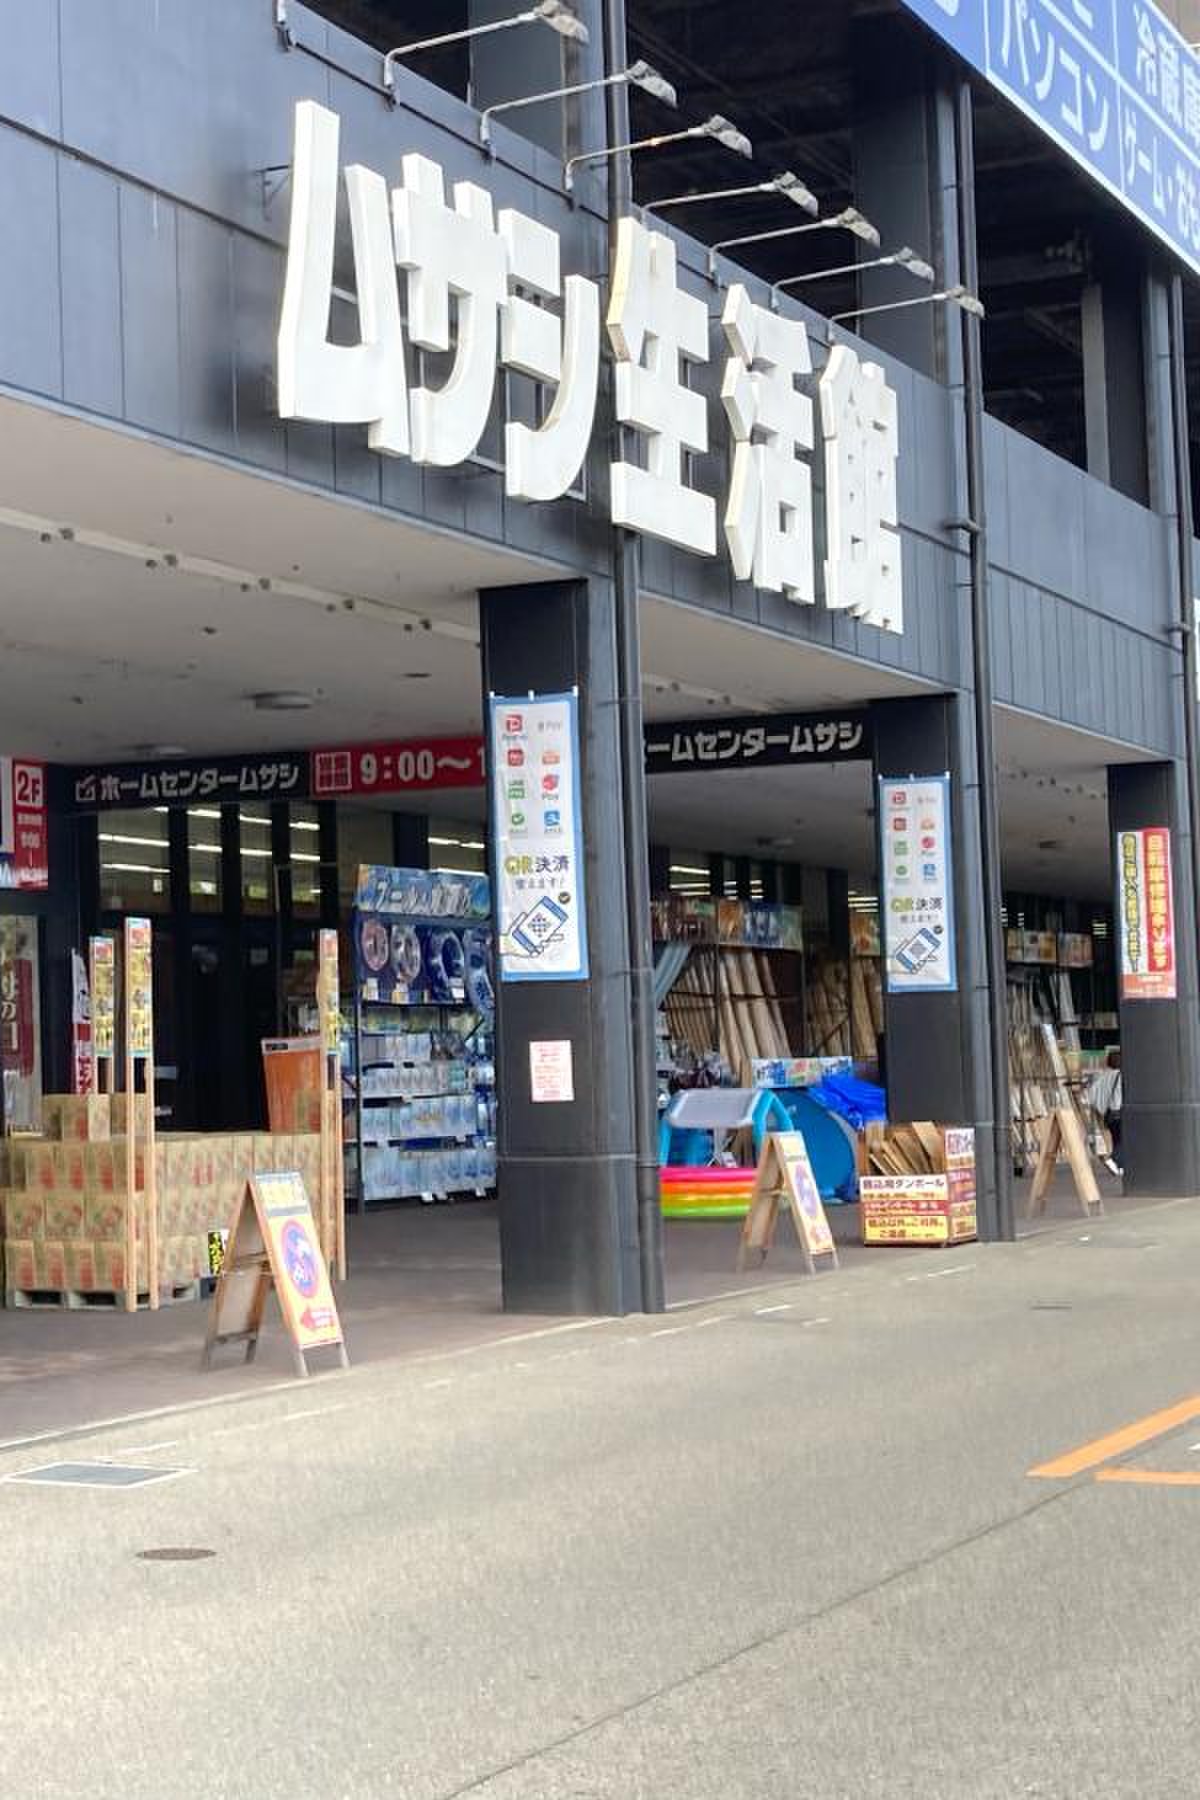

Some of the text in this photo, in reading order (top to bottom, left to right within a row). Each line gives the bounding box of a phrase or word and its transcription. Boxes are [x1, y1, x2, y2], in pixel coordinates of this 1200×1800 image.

[1002, 0, 1108, 151] パソコン
[642, 722, 863, 762] ームセンタームサシ
[17, 769, 42, 804] 2F
[101, 764, 299, 800] ホームセンタームサシ
